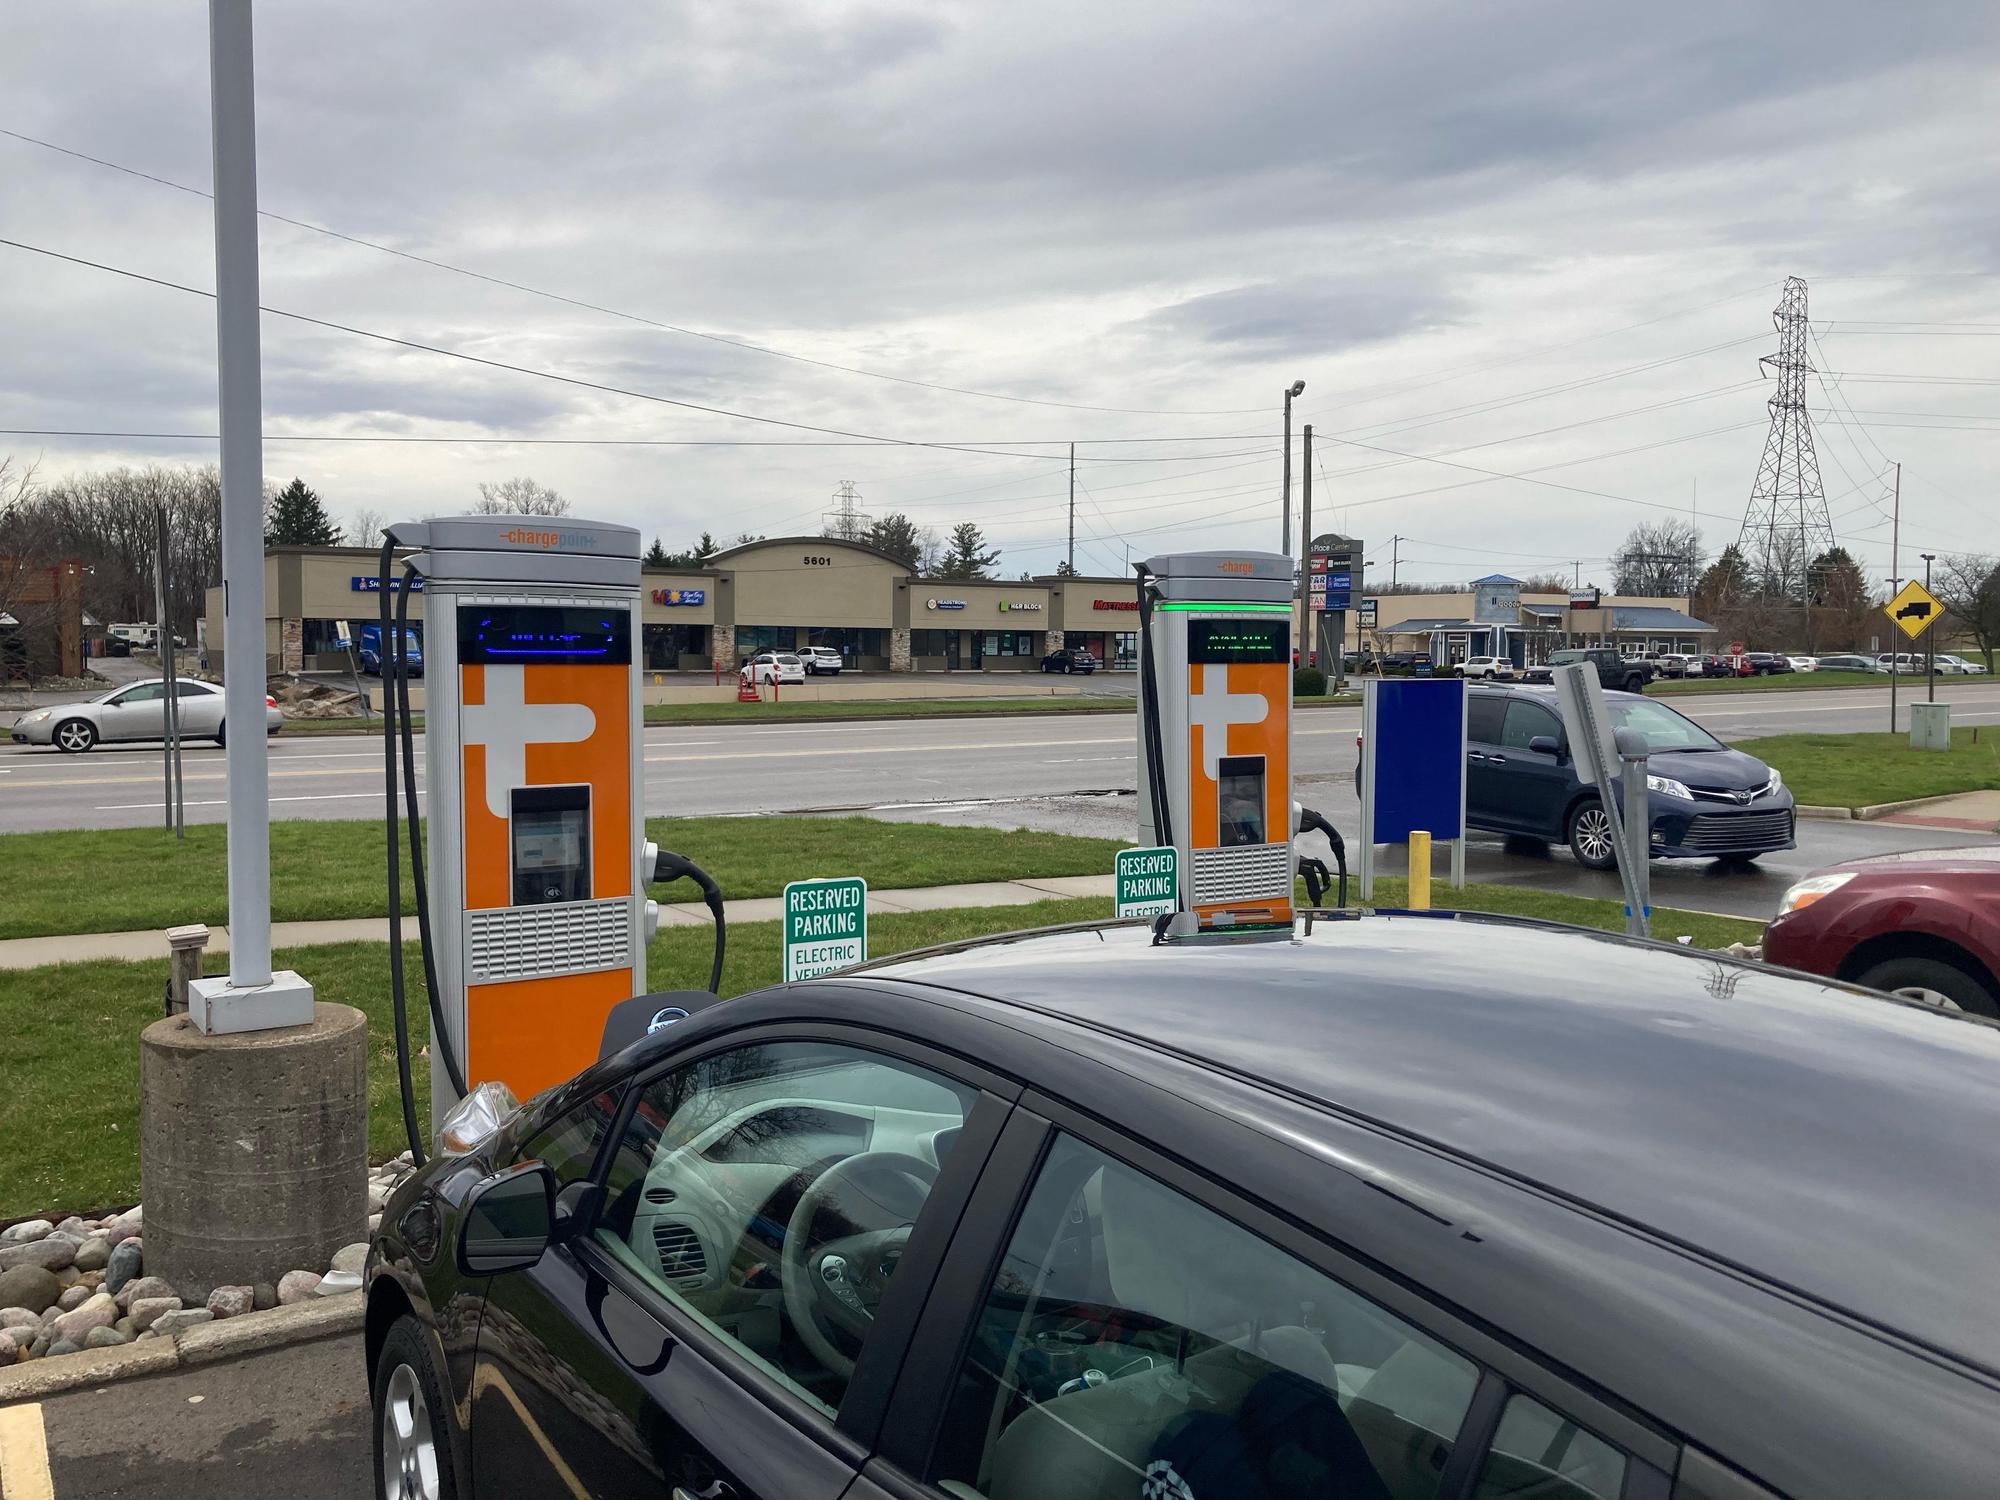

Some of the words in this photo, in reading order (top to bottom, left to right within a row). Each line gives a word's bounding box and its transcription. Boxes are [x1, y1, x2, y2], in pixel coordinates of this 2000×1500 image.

[803, 556, 831, 566] 5601
[1120, 855, 1173, 876] RESERVED
[1124, 877, 1170, 898] PARKING
[790, 887, 860, 912] RESERVED
[794, 911, 856, 937] PARKING
[796, 944, 855, 965] ELECTRIC
